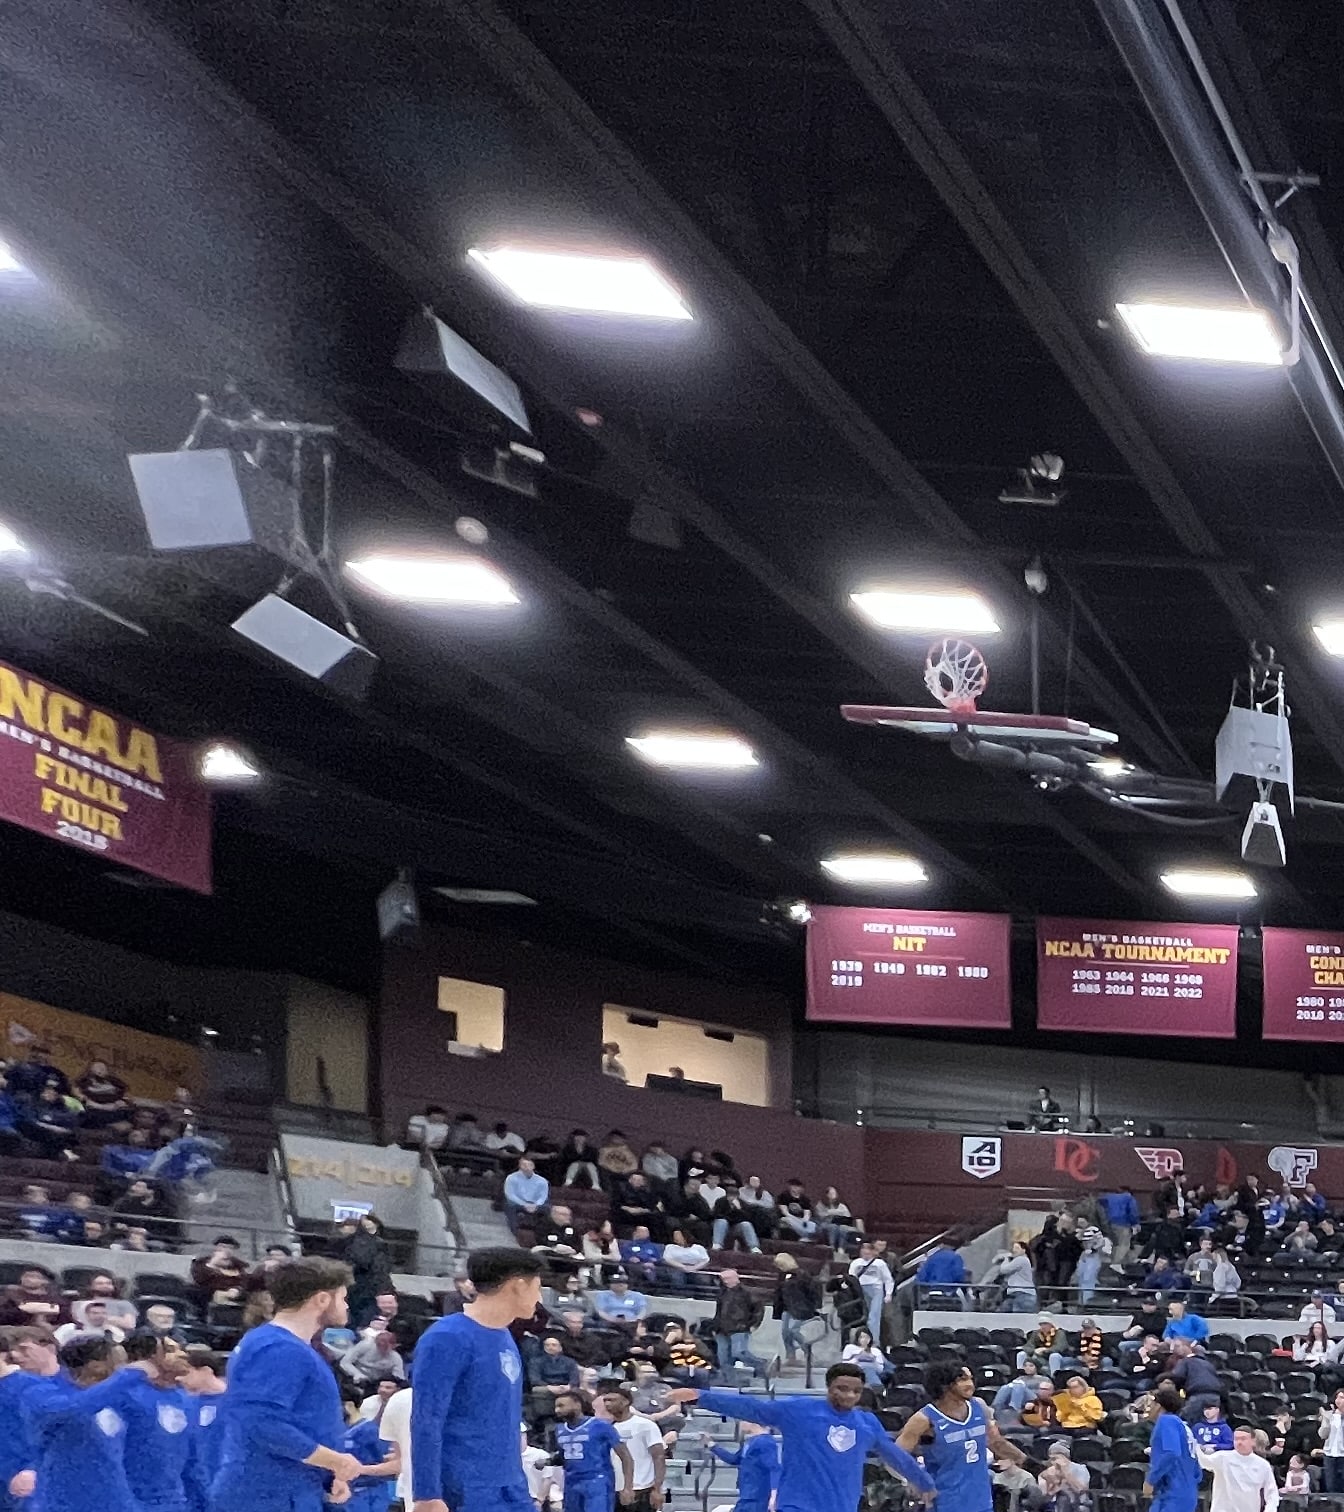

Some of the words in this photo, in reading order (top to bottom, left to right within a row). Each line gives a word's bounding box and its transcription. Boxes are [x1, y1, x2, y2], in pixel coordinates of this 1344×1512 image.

[0, 666, 164, 783] NCAA
[35, 753, 128, 812] FINAL
[41, 787, 124, 840] FOUR
[893, 936, 926, 952] NIT
[1045, 941, 1095, 957] NCAA
[1102, 944, 1230, 964] TOURNAMENT
[1141, 986, 1169, 997] 2021
[972, 1141, 995, 1153] A
[968, 1156, 996, 1166] 10
[964, 1440, 979, 1464] 2
